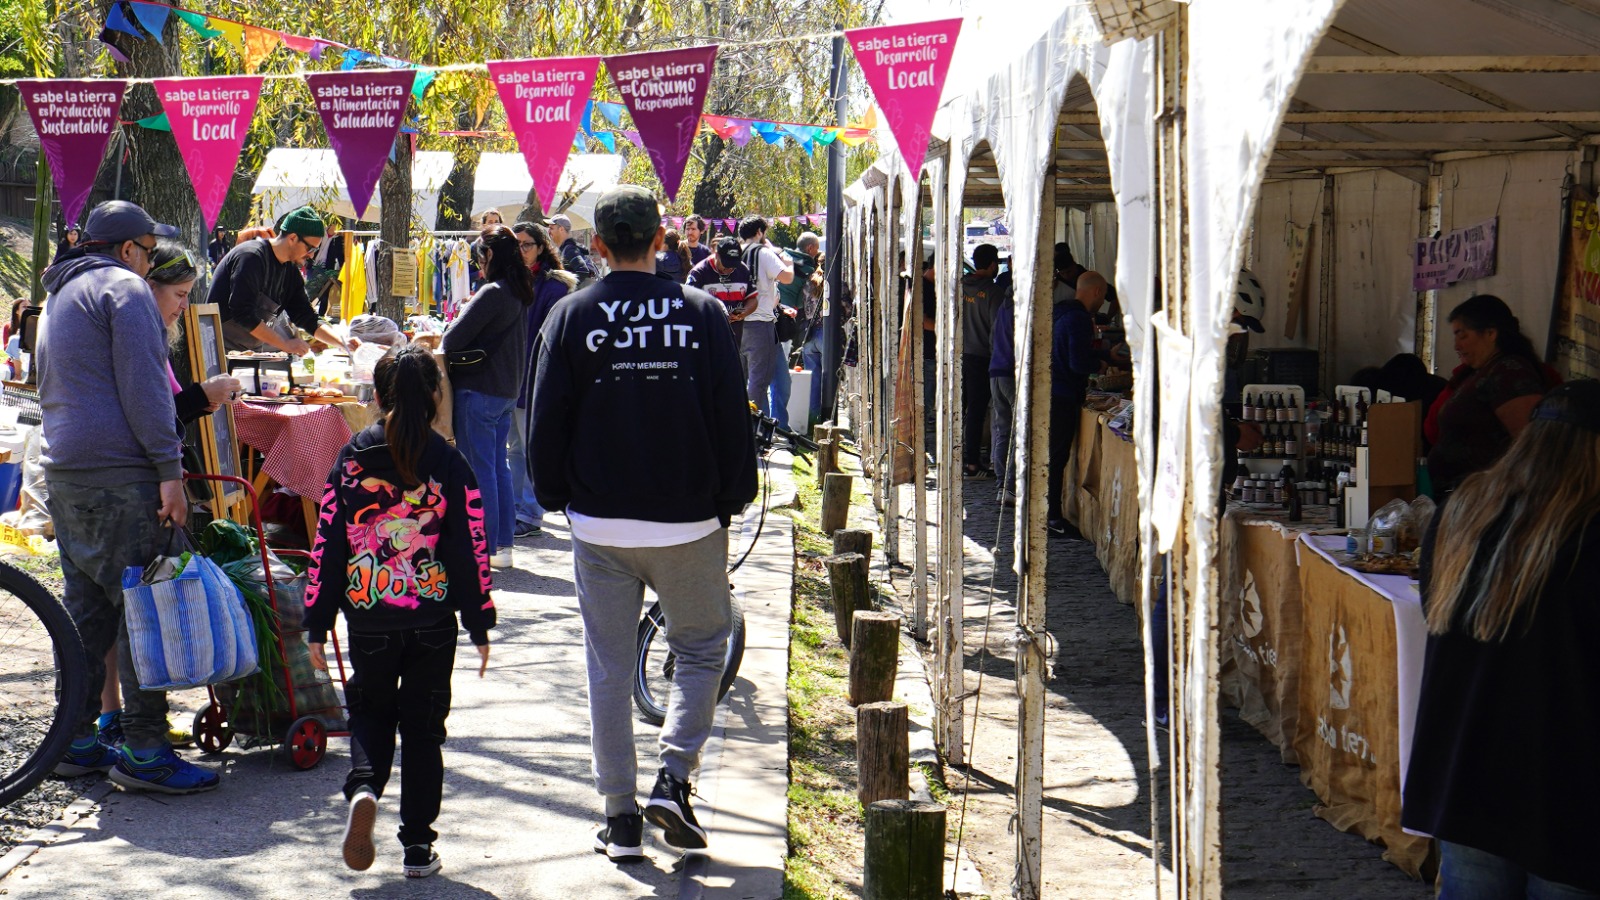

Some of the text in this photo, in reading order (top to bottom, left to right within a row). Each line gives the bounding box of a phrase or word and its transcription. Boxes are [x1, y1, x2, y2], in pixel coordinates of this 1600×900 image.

[857, 33, 948, 52] sabe la tierra
[875, 46, 938, 66] Desarrollo
[498, 68, 585, 84] sabe la tierra
[617, 62, 705, 81] sabe la tierra
[888, 63, 935, 90] Local
[33, 89, 116, 103] sabe la tierra
[165, 87, 250, 102] sabe la tierra
[317, 82, 403, 97] sabe la tierra
[515, 82, 576, 100] Desarrollo
[621, 77, 697, 98] ES Consumo
[38, 102, 111, 118] ES Producción
[182, 100, 240, 117] Desarrollo
[320, 96, 400, 112] ES Alimentación
[526, 99, 571, 123] Local
[635, 94, 694, 112] Responsable
[41, 118, 109, 136] Sustentable
[193, 117, 236, 141] Local
[333, 111, 396, 129] Saludable
[585, 324, 700, 352] GOT IT.
[637, 361, 679, 370] MEMBERS
